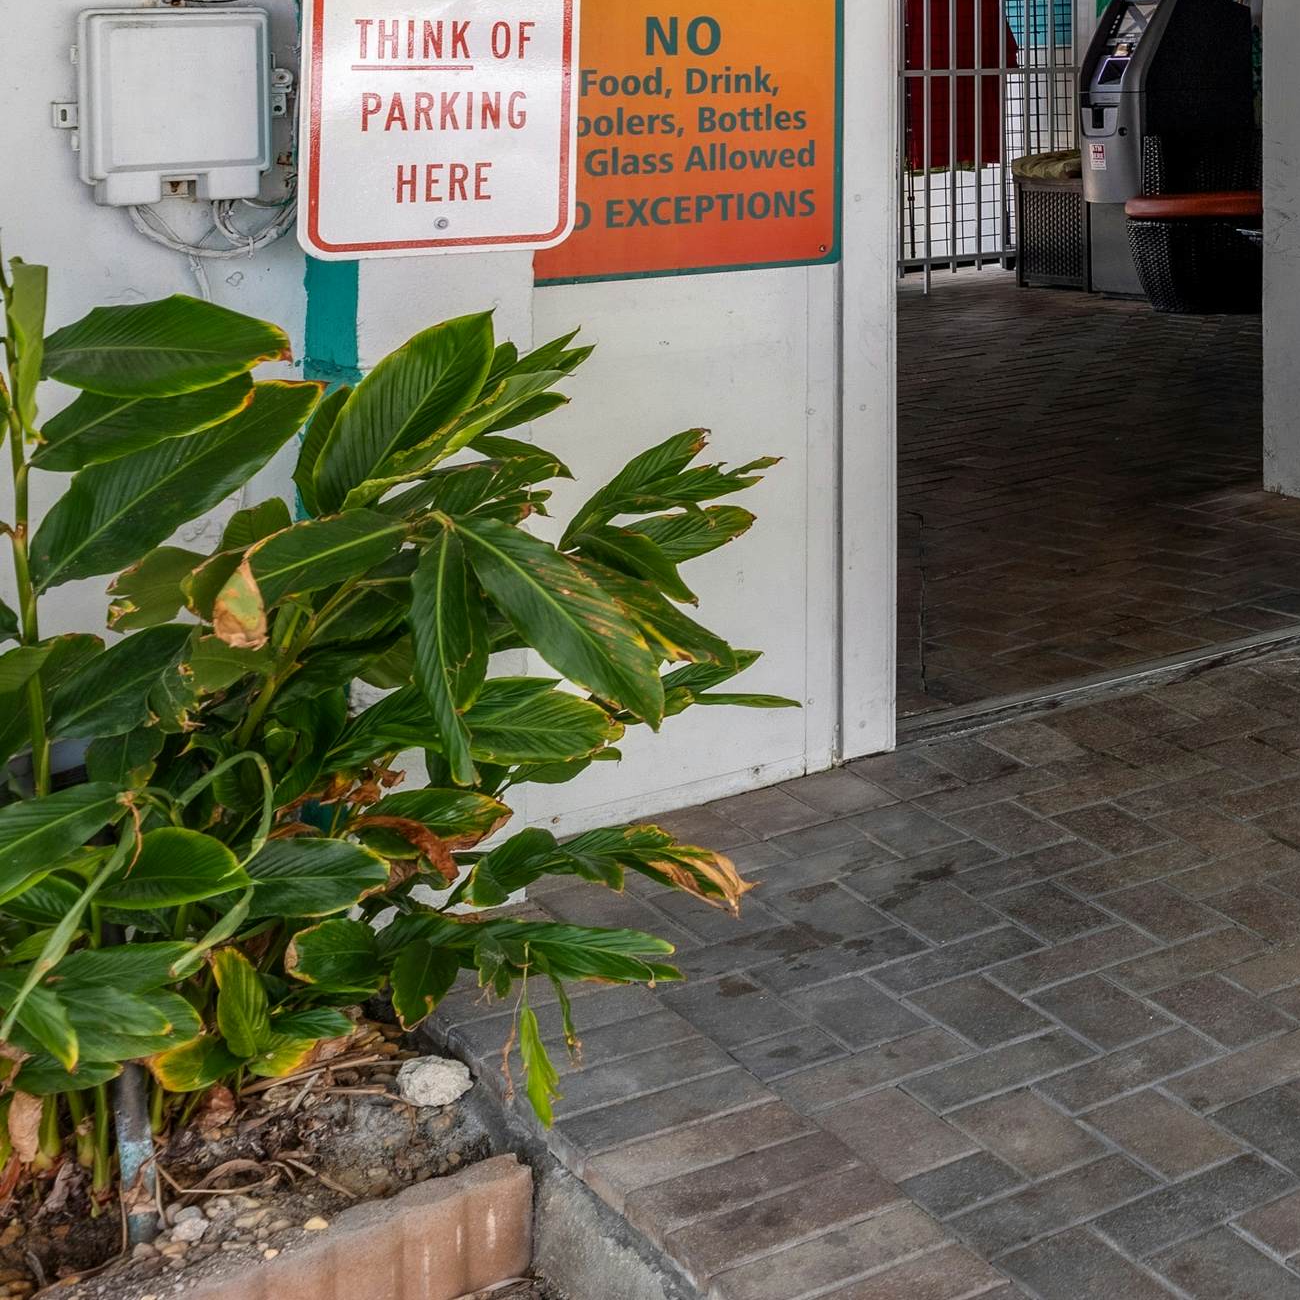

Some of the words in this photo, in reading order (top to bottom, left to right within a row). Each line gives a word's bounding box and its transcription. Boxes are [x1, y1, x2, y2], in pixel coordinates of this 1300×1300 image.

[355, 19, 471, 60] THINK
[491, 21, 536, 59] OF
[645, 16, 721, 56] NO
[581, 66, 672, 99] Food,
[685, 66, 779, 97] Drink,
[361, 91, 527, 132] PARKING
[577, 106, 684, 138] oolers,
[697, 104, 806, 133] Bottles
[585, 146, 674, 177] Glass
[684, 140, 815, 173] Allowed
[395, 162, 493, 204] HERE
[574, 200, 592, 231] O
[605, 188, 815, 229] EXCEPTIONS
